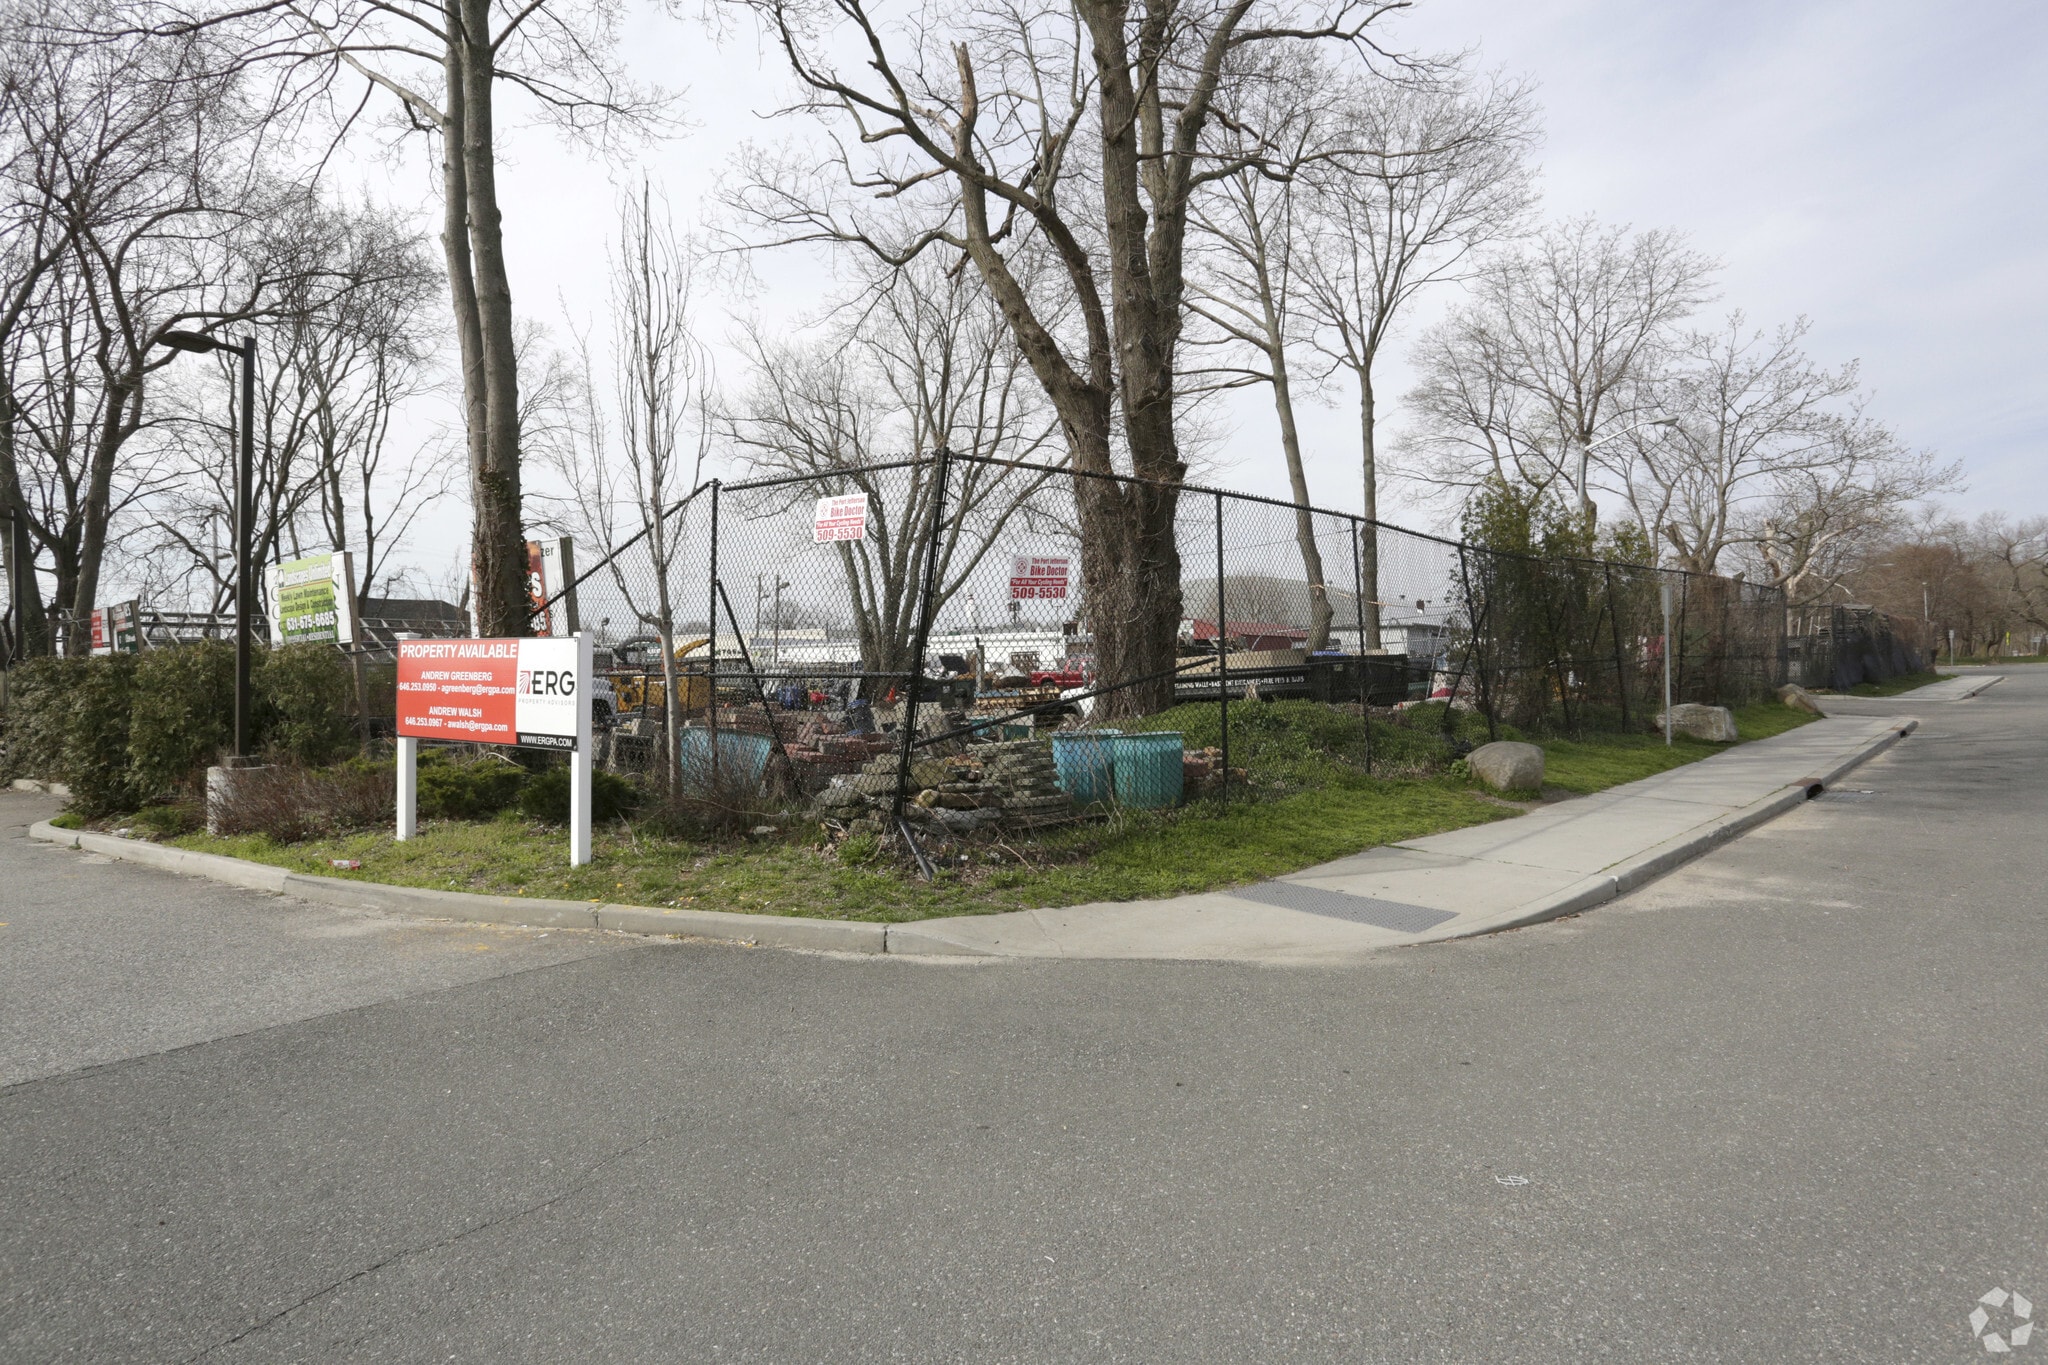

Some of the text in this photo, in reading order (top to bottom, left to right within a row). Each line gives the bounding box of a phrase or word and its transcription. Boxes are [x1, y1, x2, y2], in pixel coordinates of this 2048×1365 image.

[830, 506, 864, 518] Bike Doctor
[817, 527, 862, 541] 509-5530
[1030, 566, 1068, 576] Bike Doctor
[1012, 587, 1066, 598] 509-5530
[286, 612, 335, 630] 631-675-6685
[400, 644, 518, 658] PROPERTY AVAILABLE
[421, 671, 492, 681] ANDREW GREENBERG
[399, 682, 436, 692] 646.253.0950
[441, 684, 516, 696] agreenberg@ergpa.com
[532, 670, 576, 696] ERG
[428, 706, 482, 718] ANDREW WALSH
[405, 717, 443, 726] 646.253.0967
[448, 720, 508, 732] awalsh@ergpa.com
[520, 736, 572, 746] WWW.ERGPA.COM
